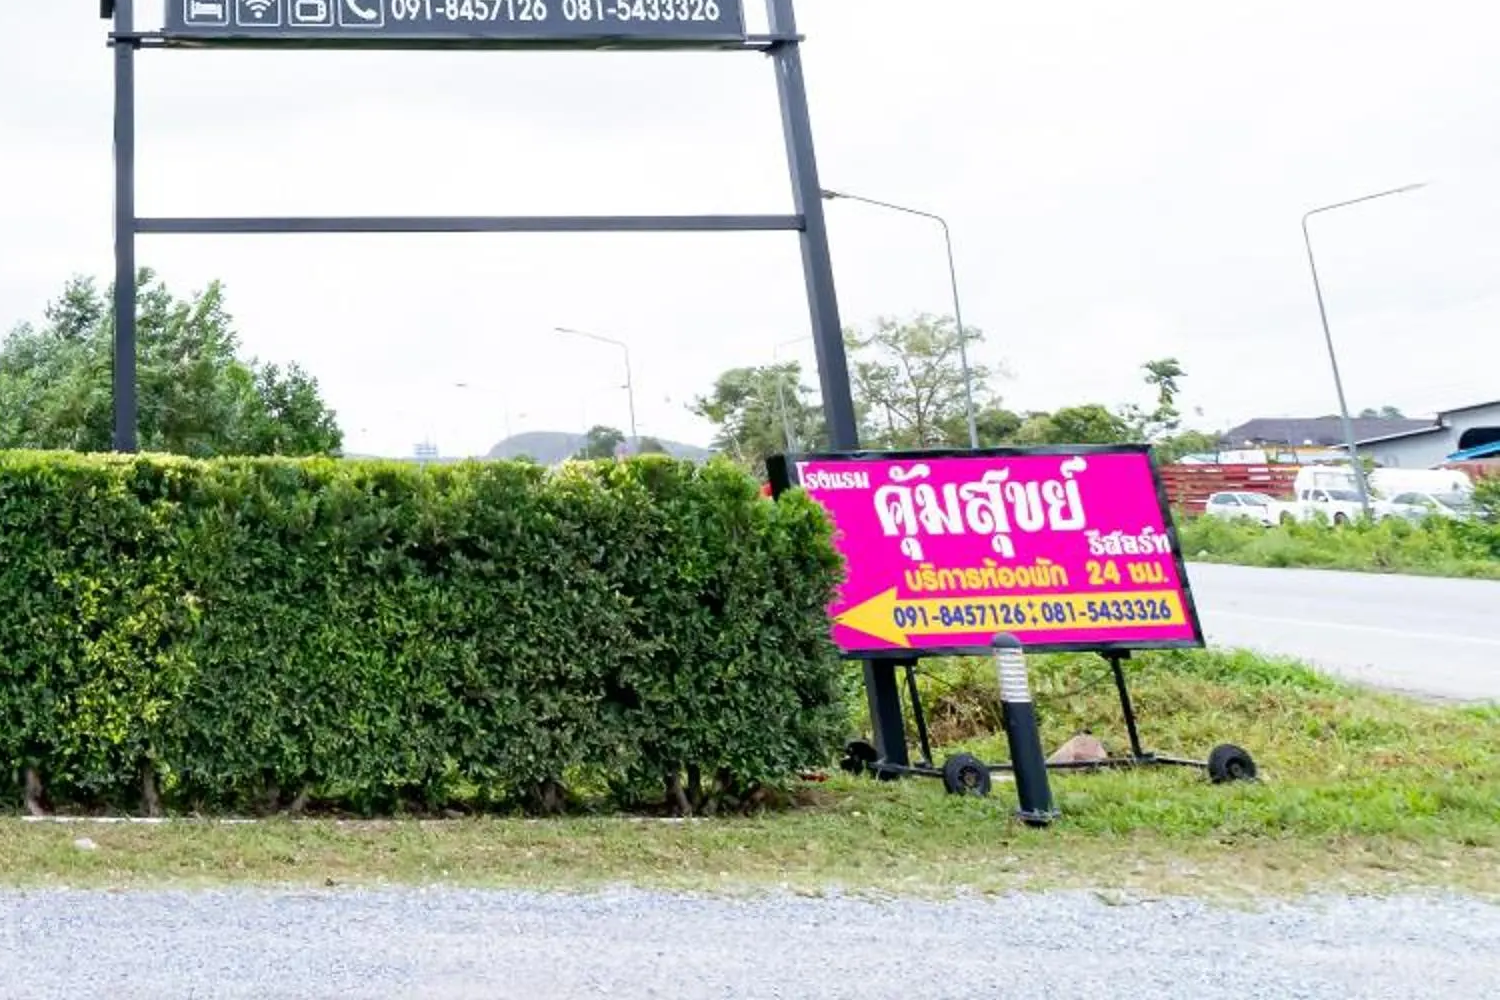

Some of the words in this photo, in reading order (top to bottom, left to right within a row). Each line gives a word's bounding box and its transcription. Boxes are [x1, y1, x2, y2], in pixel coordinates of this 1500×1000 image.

[796, 461, 871, 489] โรงแรม
[905, 557, 1068, 592] บริการห้องพัก
